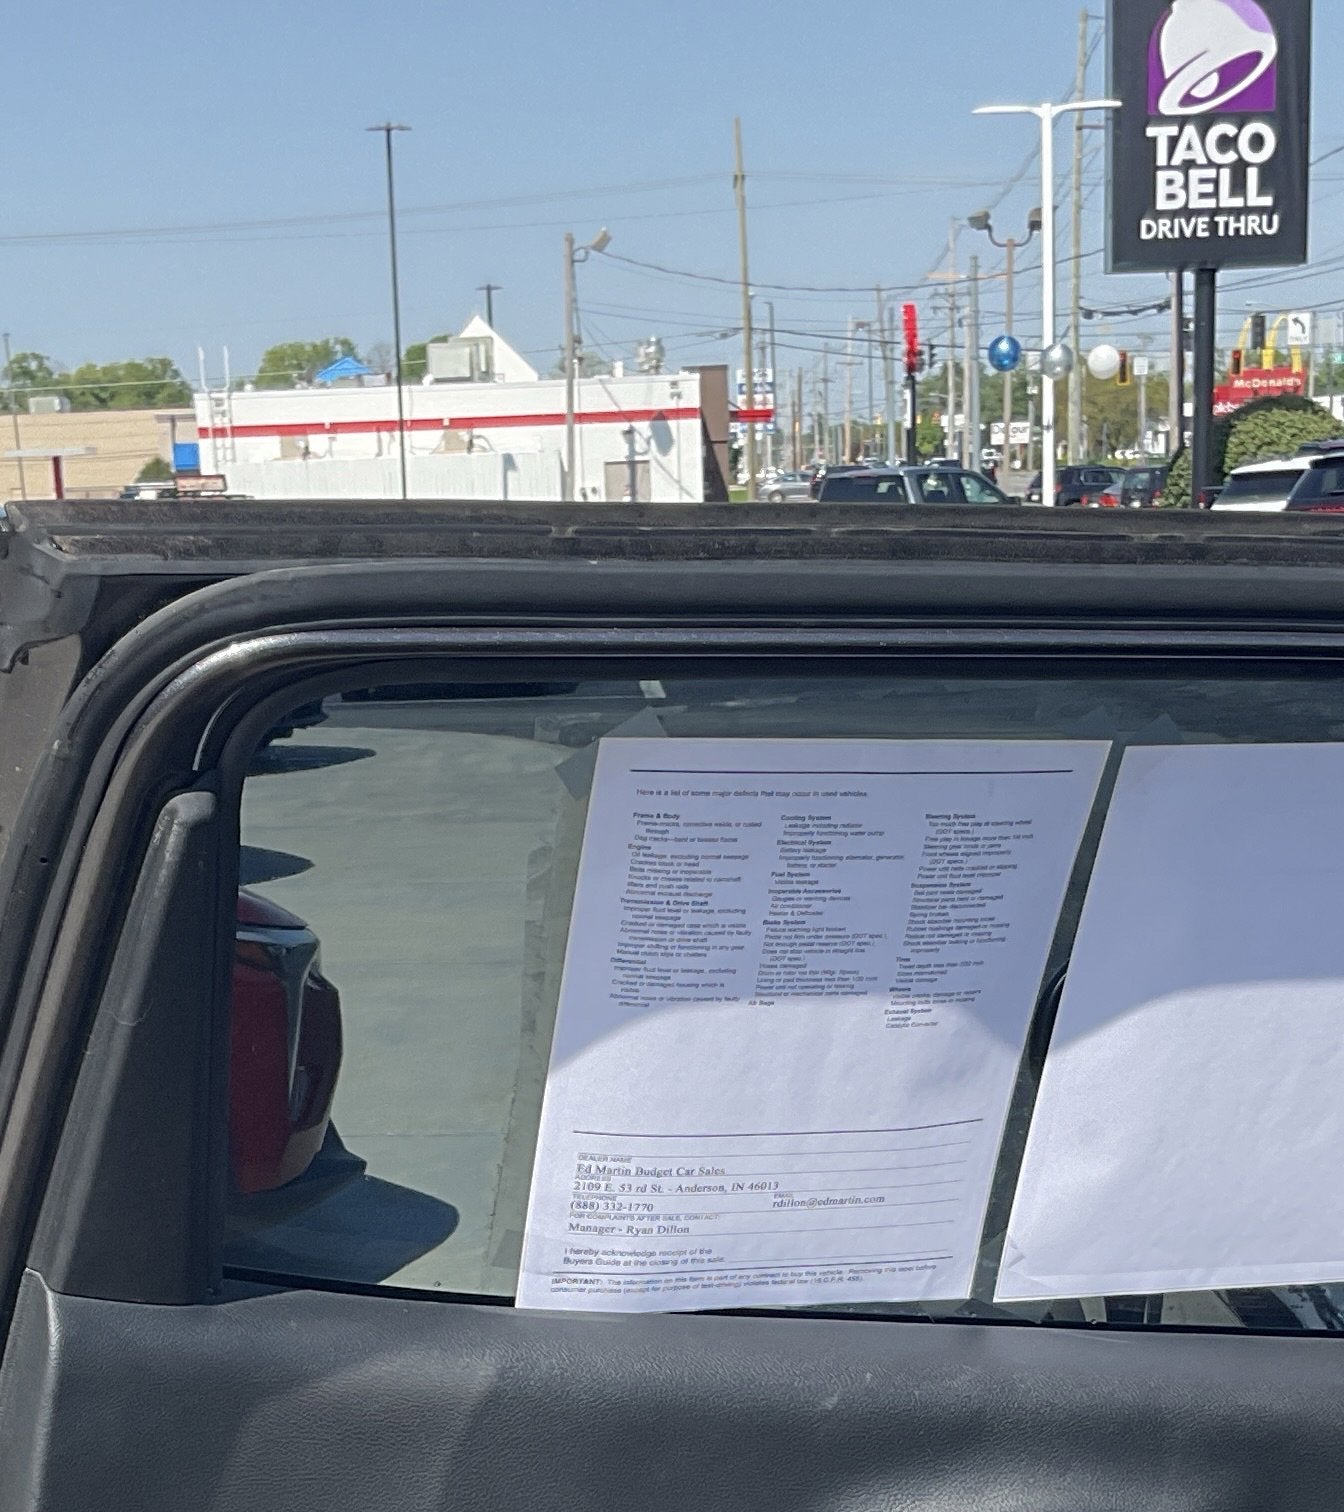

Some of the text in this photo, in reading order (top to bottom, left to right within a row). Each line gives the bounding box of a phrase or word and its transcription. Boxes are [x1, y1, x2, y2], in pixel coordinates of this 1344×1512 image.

[1145, 121, 1276, 167] TACO
[1155, 168, 1273, 211] BELL
[1139, 213, 1280, 241] DRIVE THRU
[1233, 377, 1301, 388] McDonald's
[577, 1164, 725, 1178] Ed Martin Budget Car Sales
[573, 1182, 601, 1191] 2109
[605, 1183, 615, 1192] E.
[619, 1184, 632, 1193] 53
[636, 1184, 647, 1193] rd
[650, 1184, 664, 1193] St.
[676, 1183, 727, 1193] Anderson,
[731, 1182, 744, 1192] IN
[748, 1182, 779, 1191] 46013
[570, 1202, 653, 1212] (888) 332-1770
[773, 1196, 885, 1208] rdillon@edmartin.com
[568, 1223, 615, 1234] Manager
[626, 1225, 654, 1236] Ryan
[657, 1225, 689, 1234] Dillon
[570, 1248, 599, 1256] hereby
[601, 1249, 656, 1258] acknowledge
[659, 1248, 686, 1257] receipt
[689, 1247, 697, 1255] of
[699, 1247, 712, 1255] the
[563, 1257, 593, 1266] Buyers
[596, 1257, 620, 1266] Guide
[634, 1258, 646, 1266] the
[649, 1258, 678, 1267] closing
[681, 1257, 688, 1265] of
